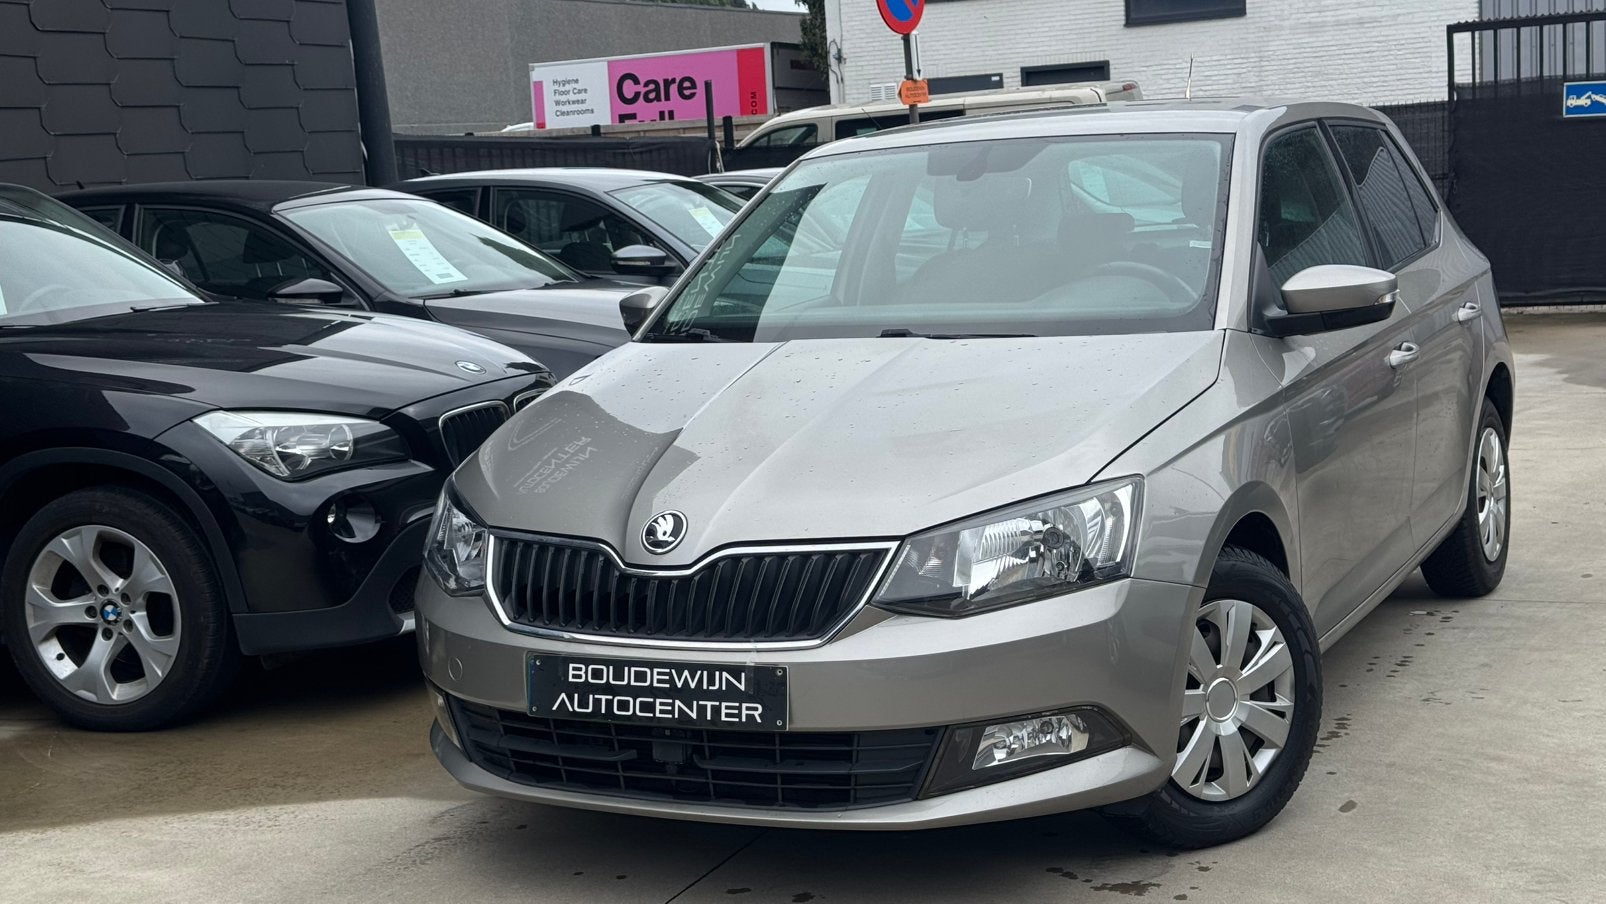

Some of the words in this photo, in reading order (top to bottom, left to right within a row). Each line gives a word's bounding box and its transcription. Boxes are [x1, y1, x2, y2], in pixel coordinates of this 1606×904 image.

[552, 78, 580, 87] Hygiene
[553, 89, 571, 97] Floor
[572, 87, 588, 95] Care
[617, 72, 697, 106] Care
[554, 98, 587, 107] Workwear
[555, 108, 595, 118] Cleanrooms
[568, 663, 746, 692] BOUDEWIJN
[551, 692, 763, 723] AUTOCENTER
